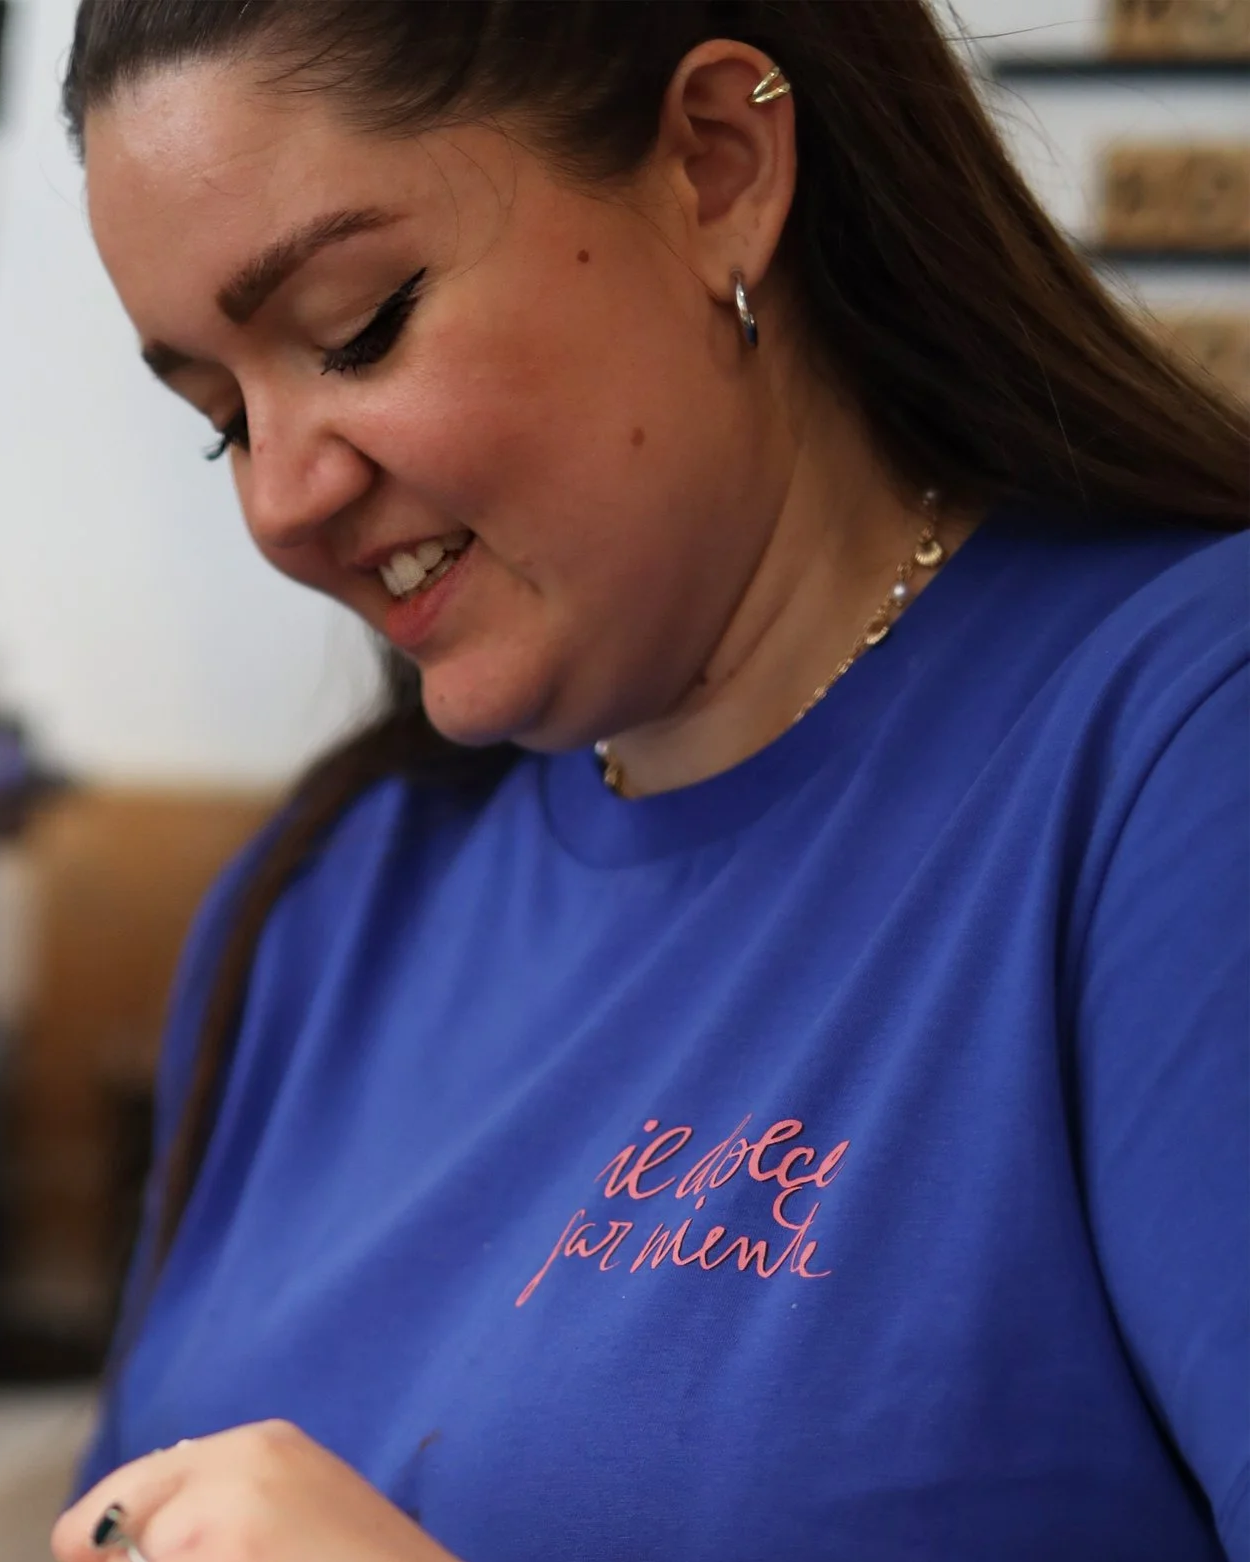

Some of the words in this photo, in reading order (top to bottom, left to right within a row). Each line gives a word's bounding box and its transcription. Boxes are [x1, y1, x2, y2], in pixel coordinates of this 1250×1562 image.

[595, 1119, 693, 1200] il
[675, 1113, 850, 1199] dolce
[515, 1208, 633, 1307] far
[630, 1189, 832, 1279] niente
